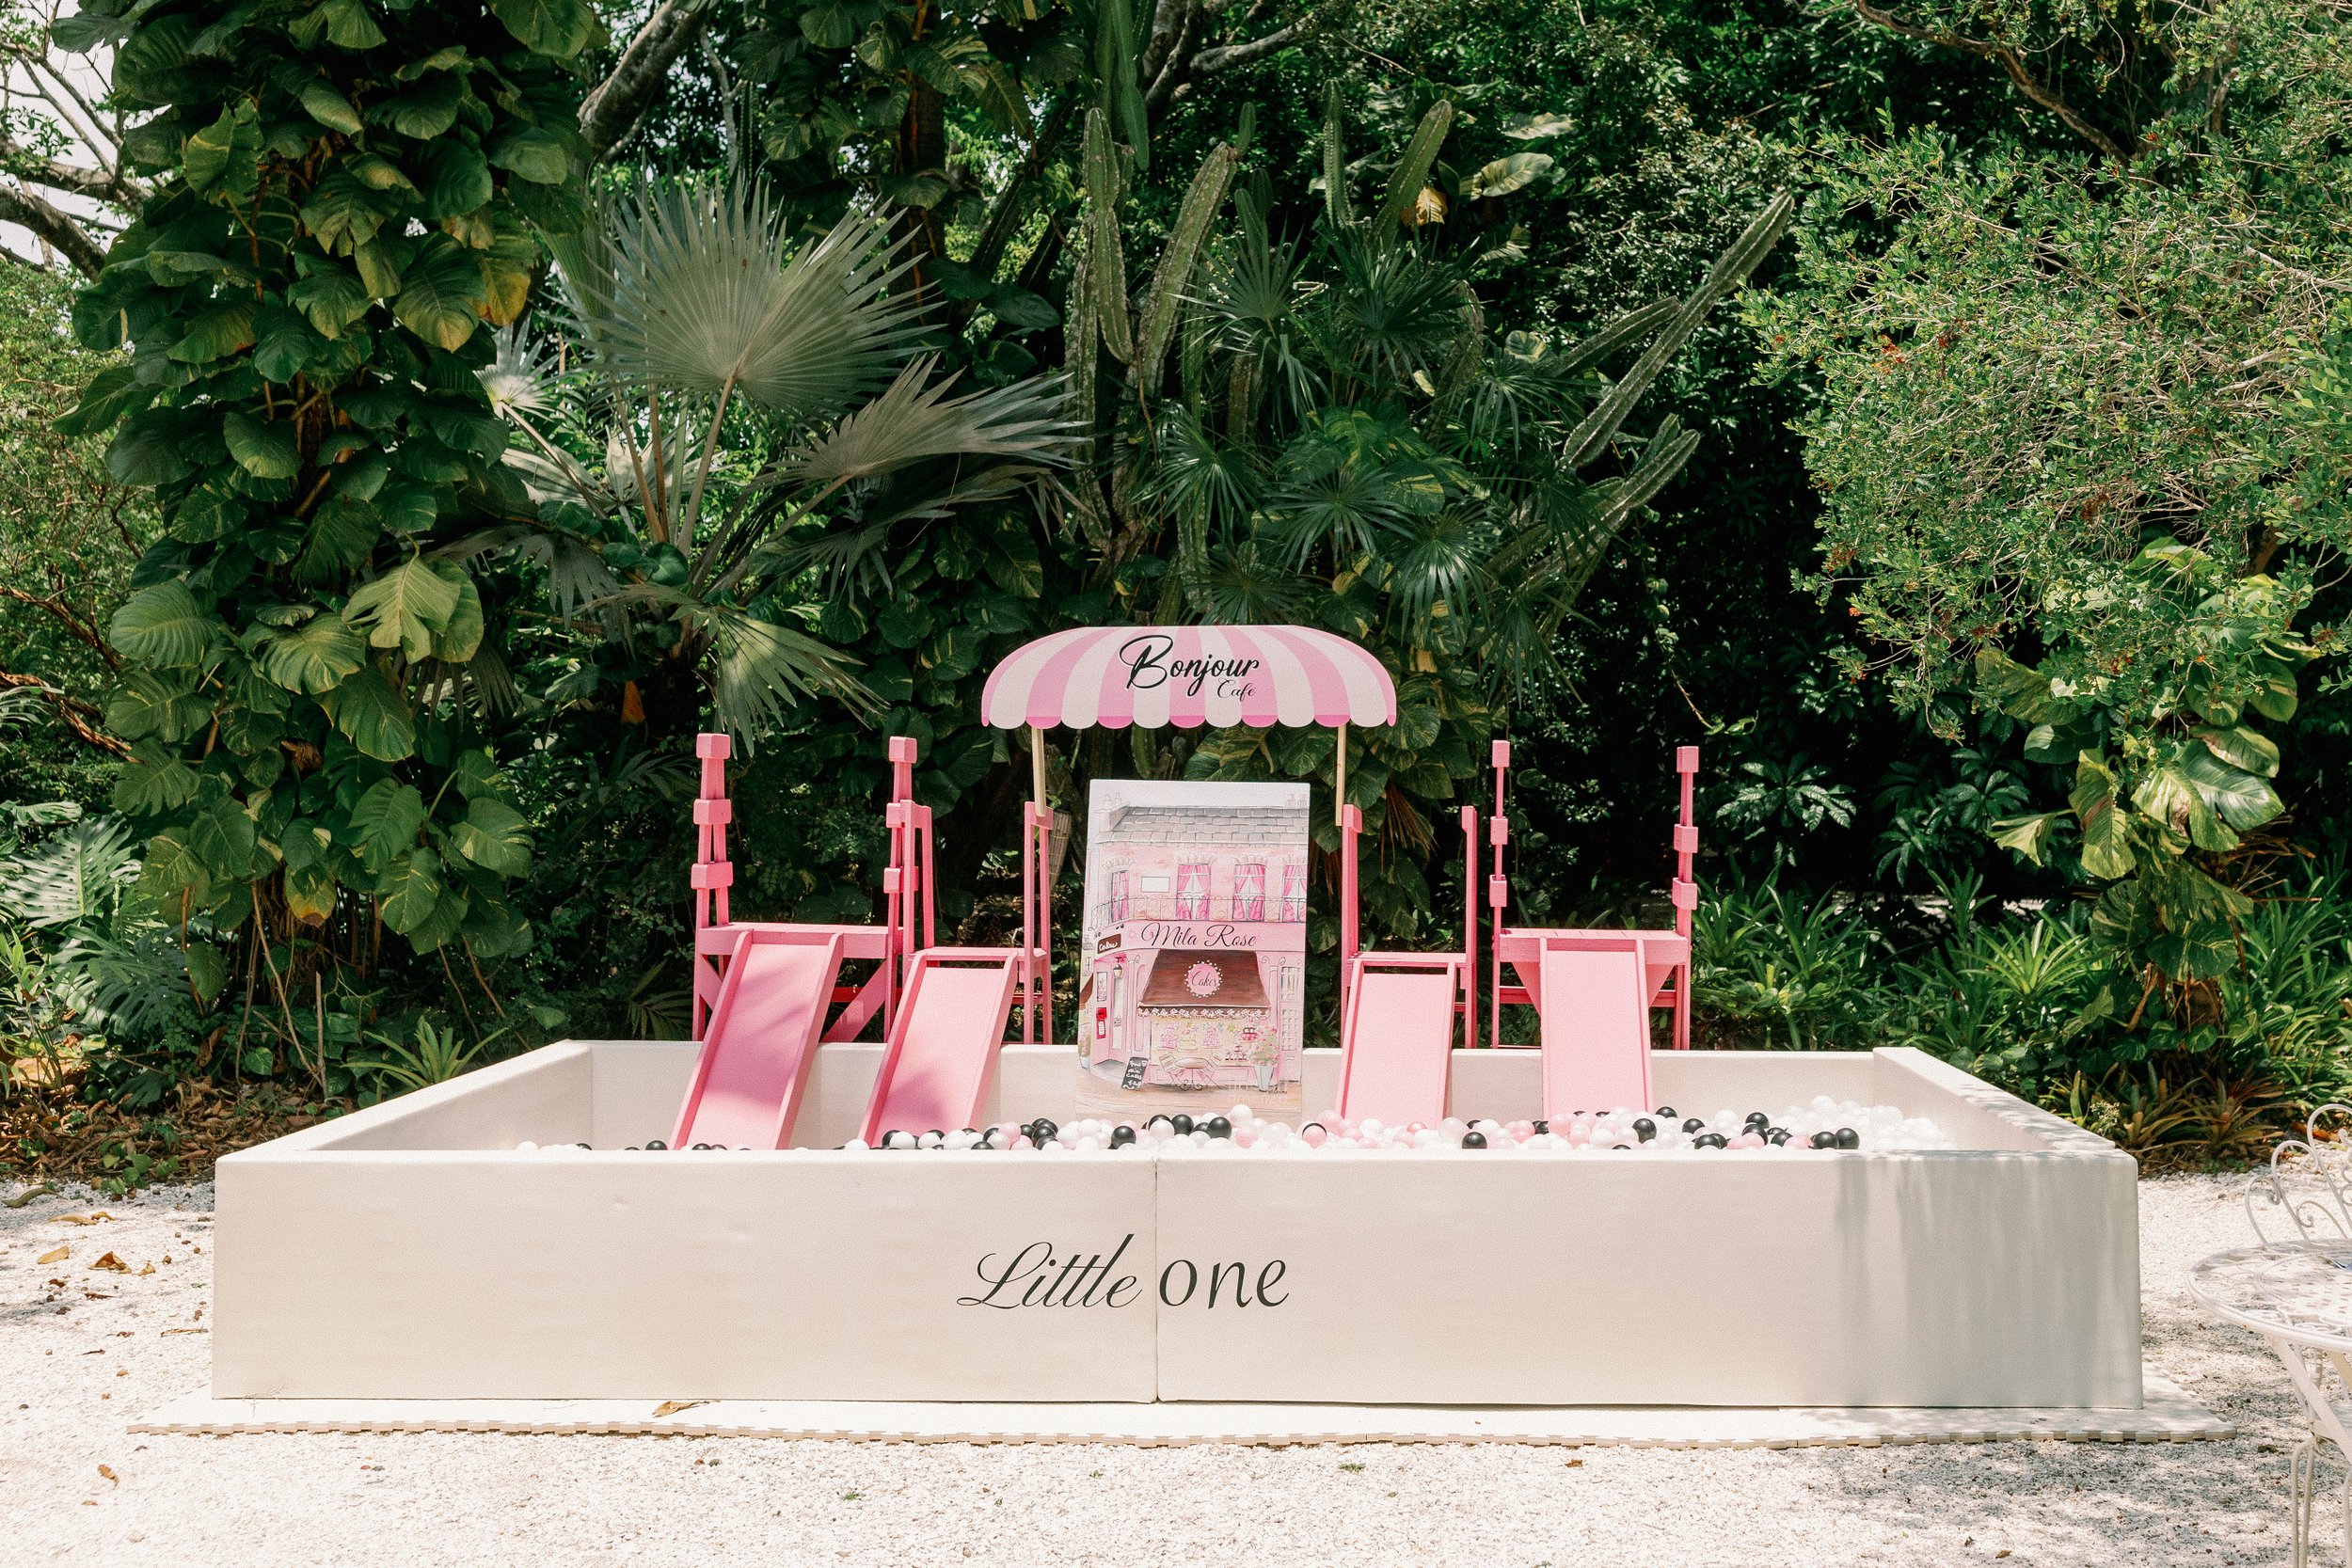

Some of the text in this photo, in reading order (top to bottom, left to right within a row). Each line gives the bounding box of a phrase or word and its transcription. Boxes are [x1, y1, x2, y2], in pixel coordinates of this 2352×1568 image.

[1120, 635, 1259, 696] Bonjour
[1141, 922, 1257, 947] Mila Rose
[1191, 971, 1216, 987] Cakes
[956, 1233, 1290, 1309] Little one
